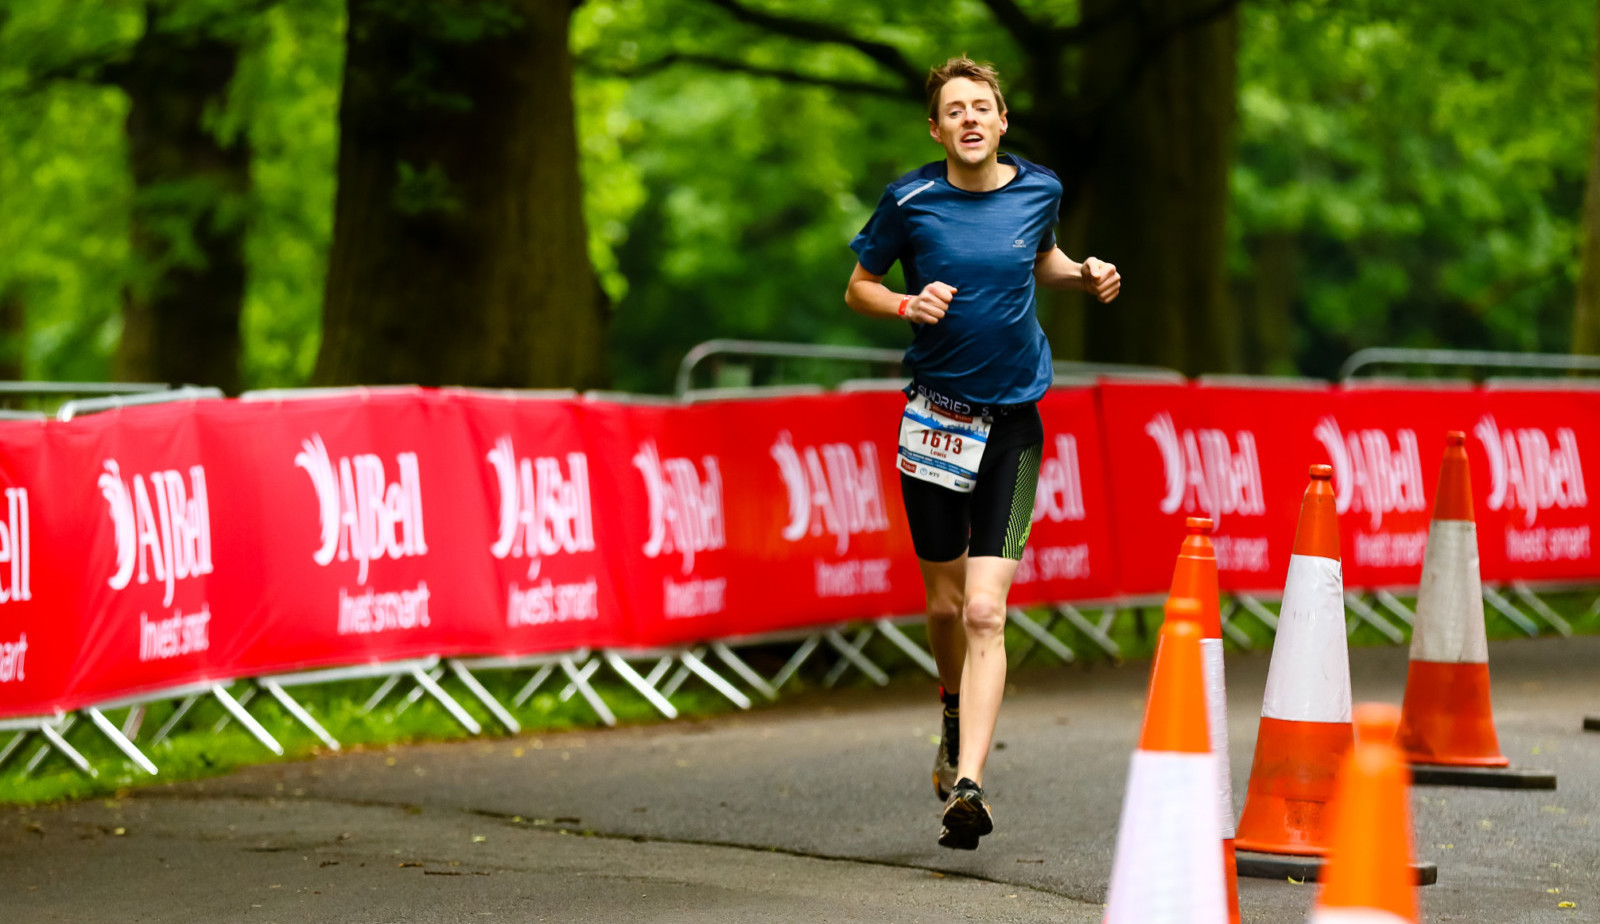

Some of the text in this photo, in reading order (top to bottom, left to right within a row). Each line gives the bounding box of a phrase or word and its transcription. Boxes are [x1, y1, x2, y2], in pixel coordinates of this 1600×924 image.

[918, 385, 971, 415] SUNDRIED
[921, 429, 963, 455] 1613
[930, 449, 947, 458] Lewis
[0, 487, 32, 604] ell
